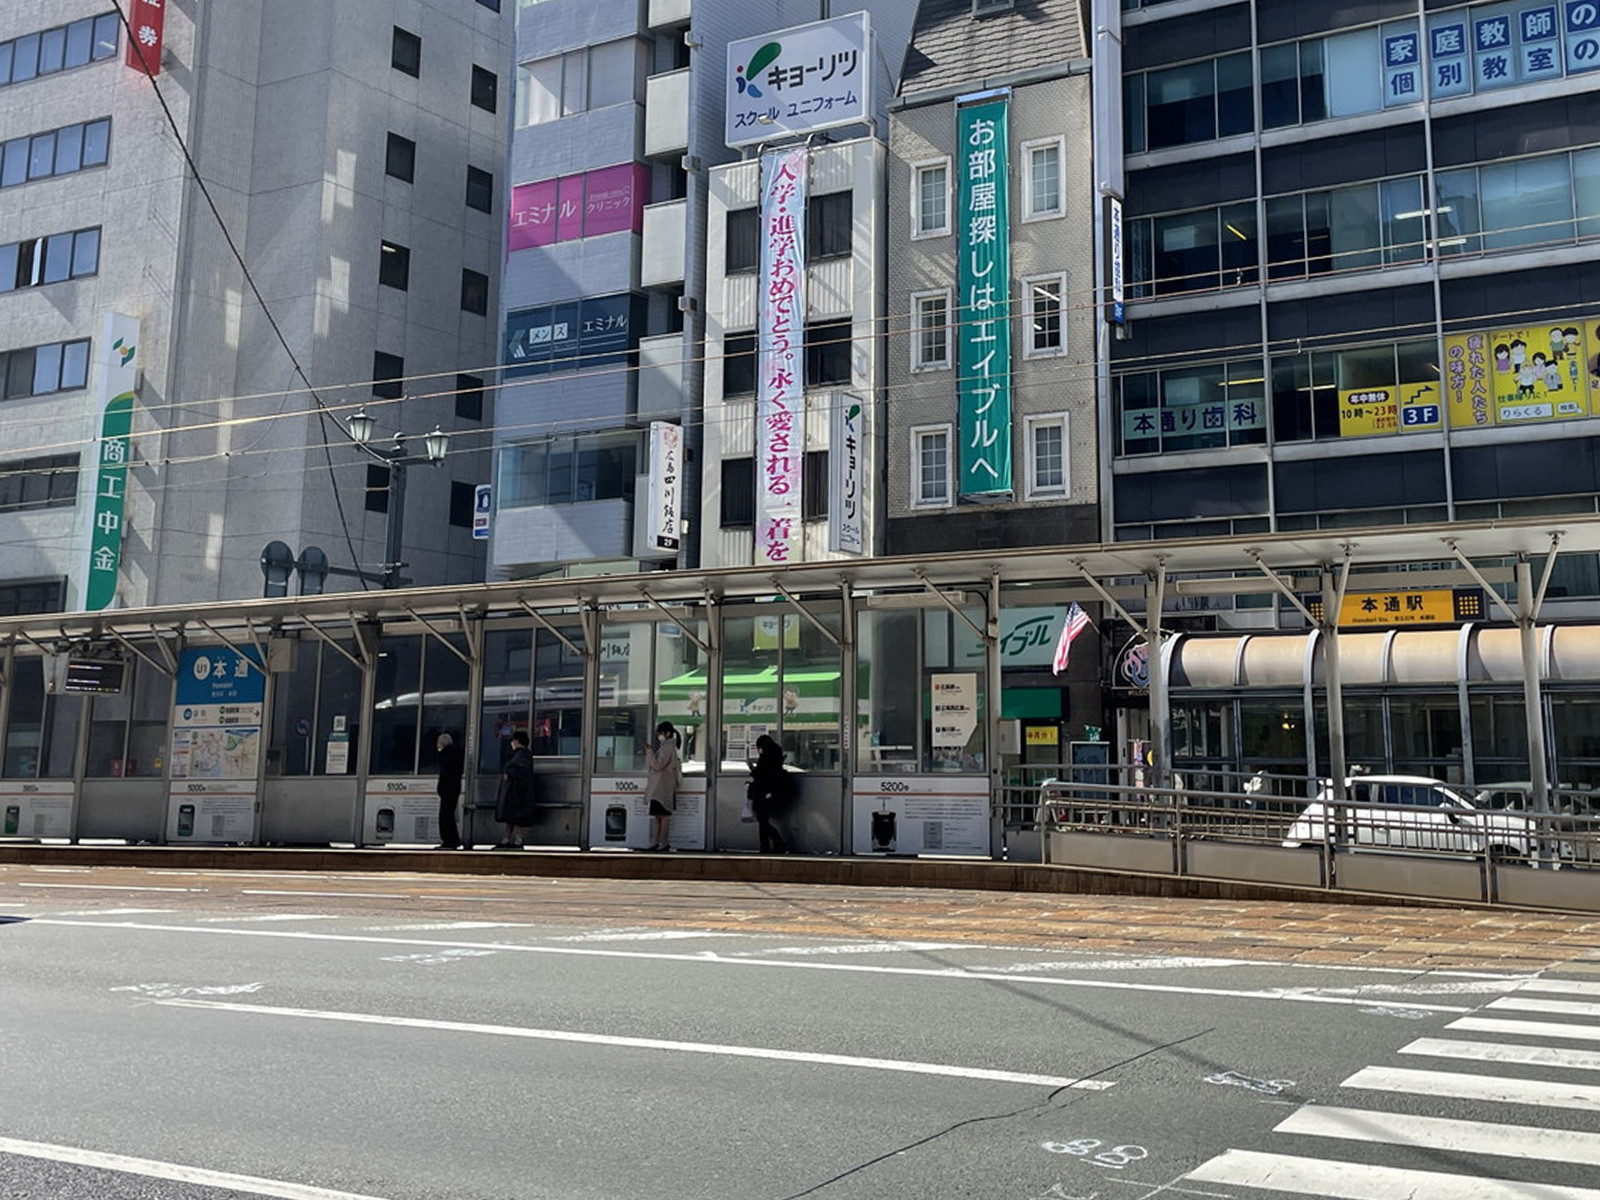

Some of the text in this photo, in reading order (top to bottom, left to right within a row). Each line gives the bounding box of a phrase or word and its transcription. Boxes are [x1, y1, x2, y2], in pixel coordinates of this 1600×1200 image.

[1389, 4, 1597, 62] 家庭教師の
[767, 49, 858, 91] キョーリツ
[1391, 38, 1599, 96] 個別教室の
[735, 90, 858, 128] スクール ユニフォーム
[512, 199, 577, 227] エミナル
[587, 195, 631, 214] クリニック
[968, 118, 1000, 478] お部屋探しはエイブルへ
[532, 314, 627, 342] メンズ エミナル
[1449, 346, 1466, 404] の味方！
[1133, 401, 1257, 435] 本通り歯科
[1407, 407, 1433, 424] 3F
[1503, 405, 1543, 418] りらくる
[845, 434, 857, 519] キョーリツ
[93, 439, 126, 572] 商工中金
[1361, 595, 1424, 613] 本通駅
